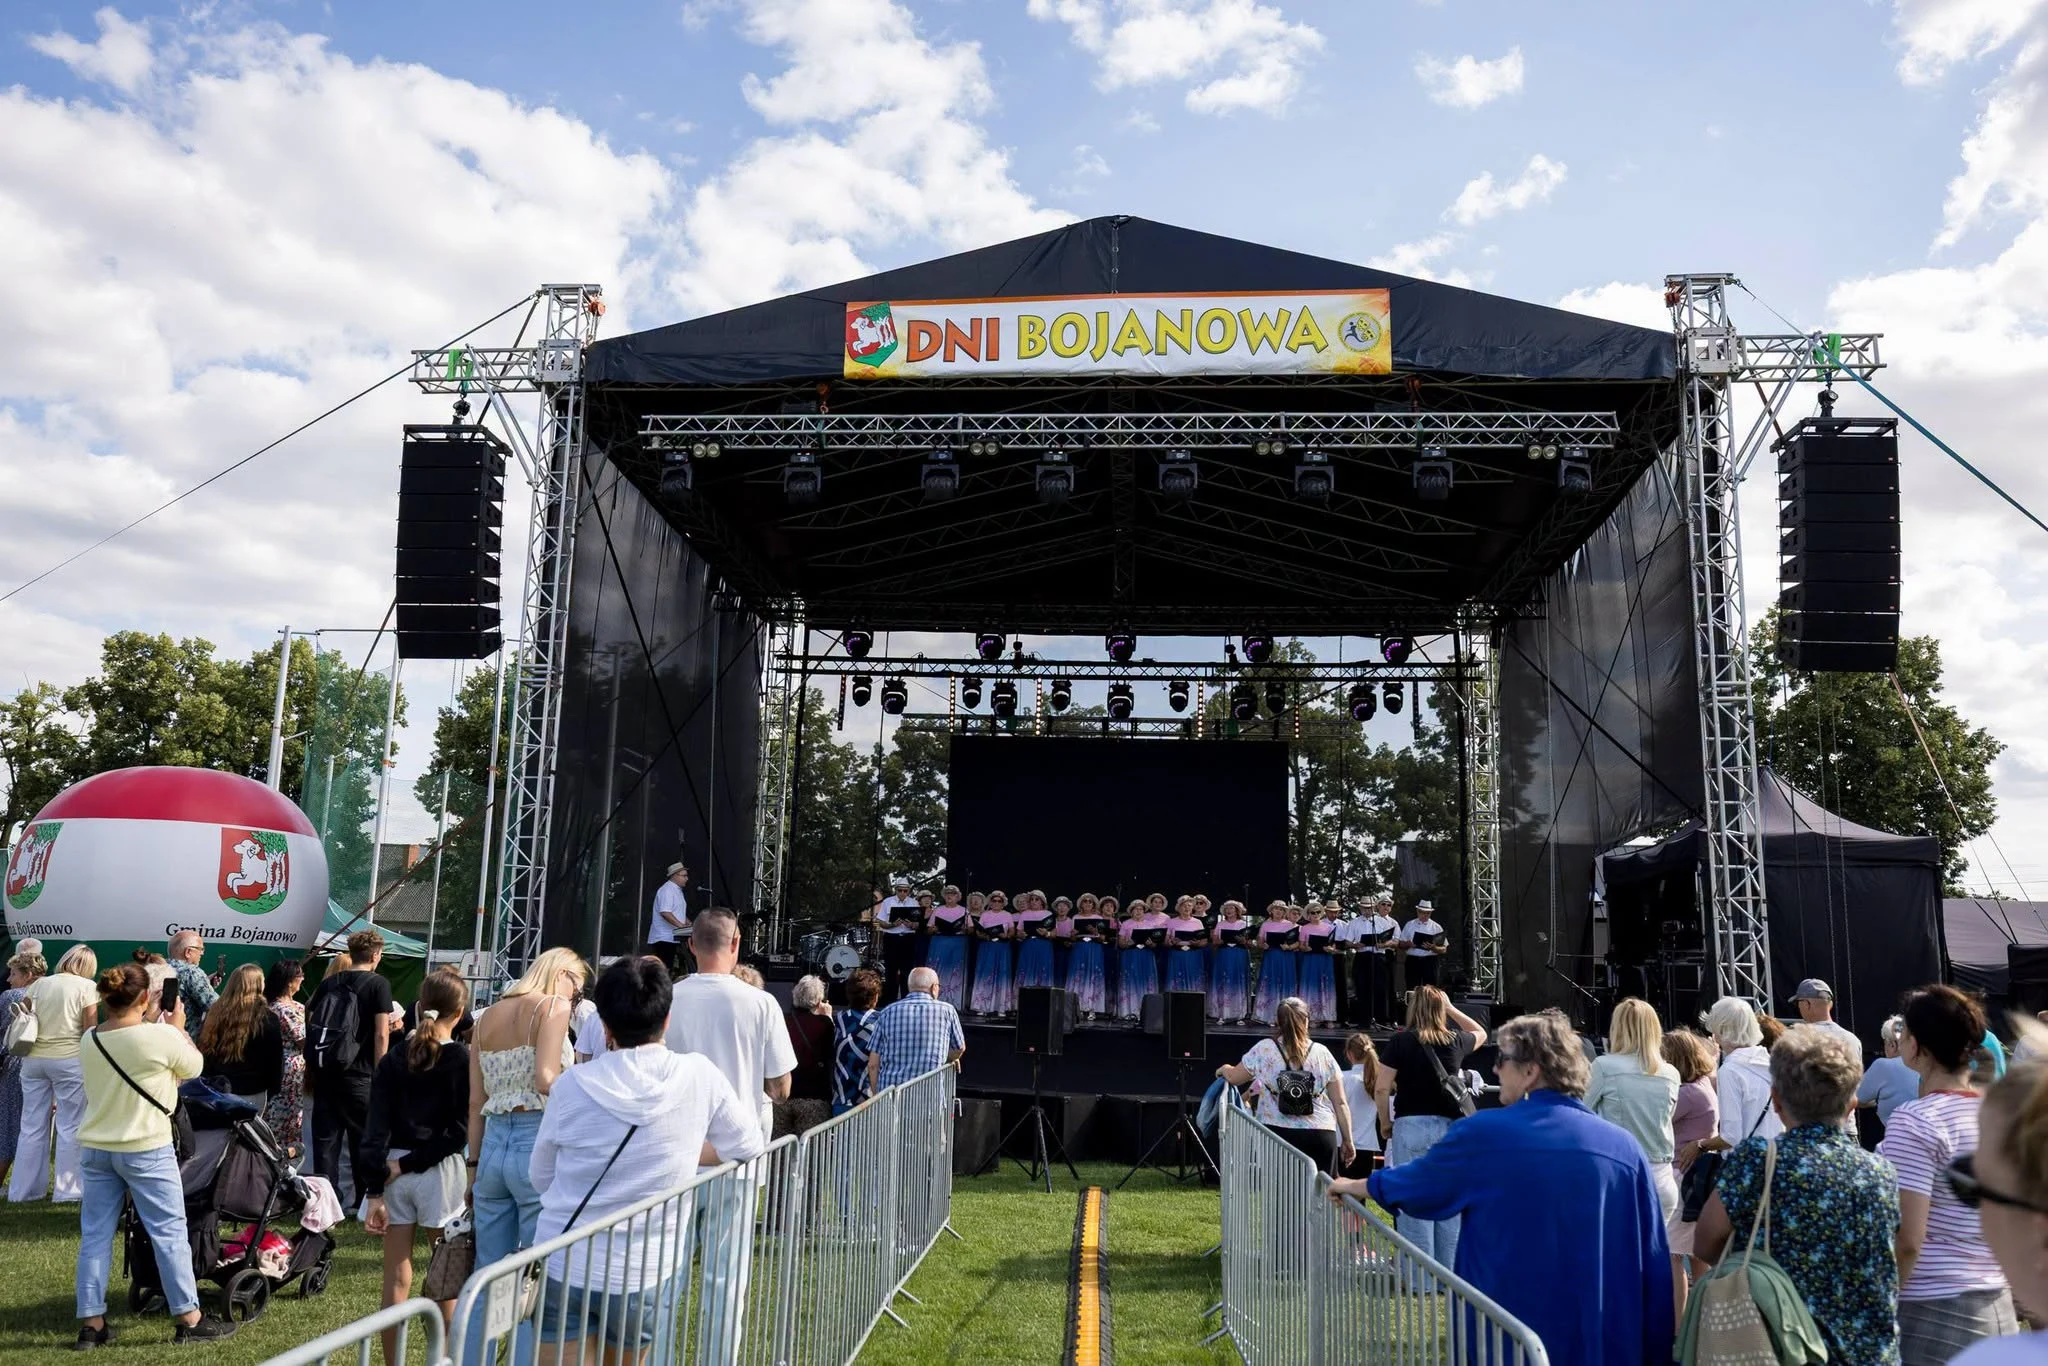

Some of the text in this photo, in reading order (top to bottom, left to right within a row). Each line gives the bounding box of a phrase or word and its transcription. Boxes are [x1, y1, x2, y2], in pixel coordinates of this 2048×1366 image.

[906, 317, 1000, 363] DNI
[1017, 305, 1329, 363] BOJANOWA
[16, 921, 73, 938] Bojanowo
[231, 926, 298, 943] Bojanowo
